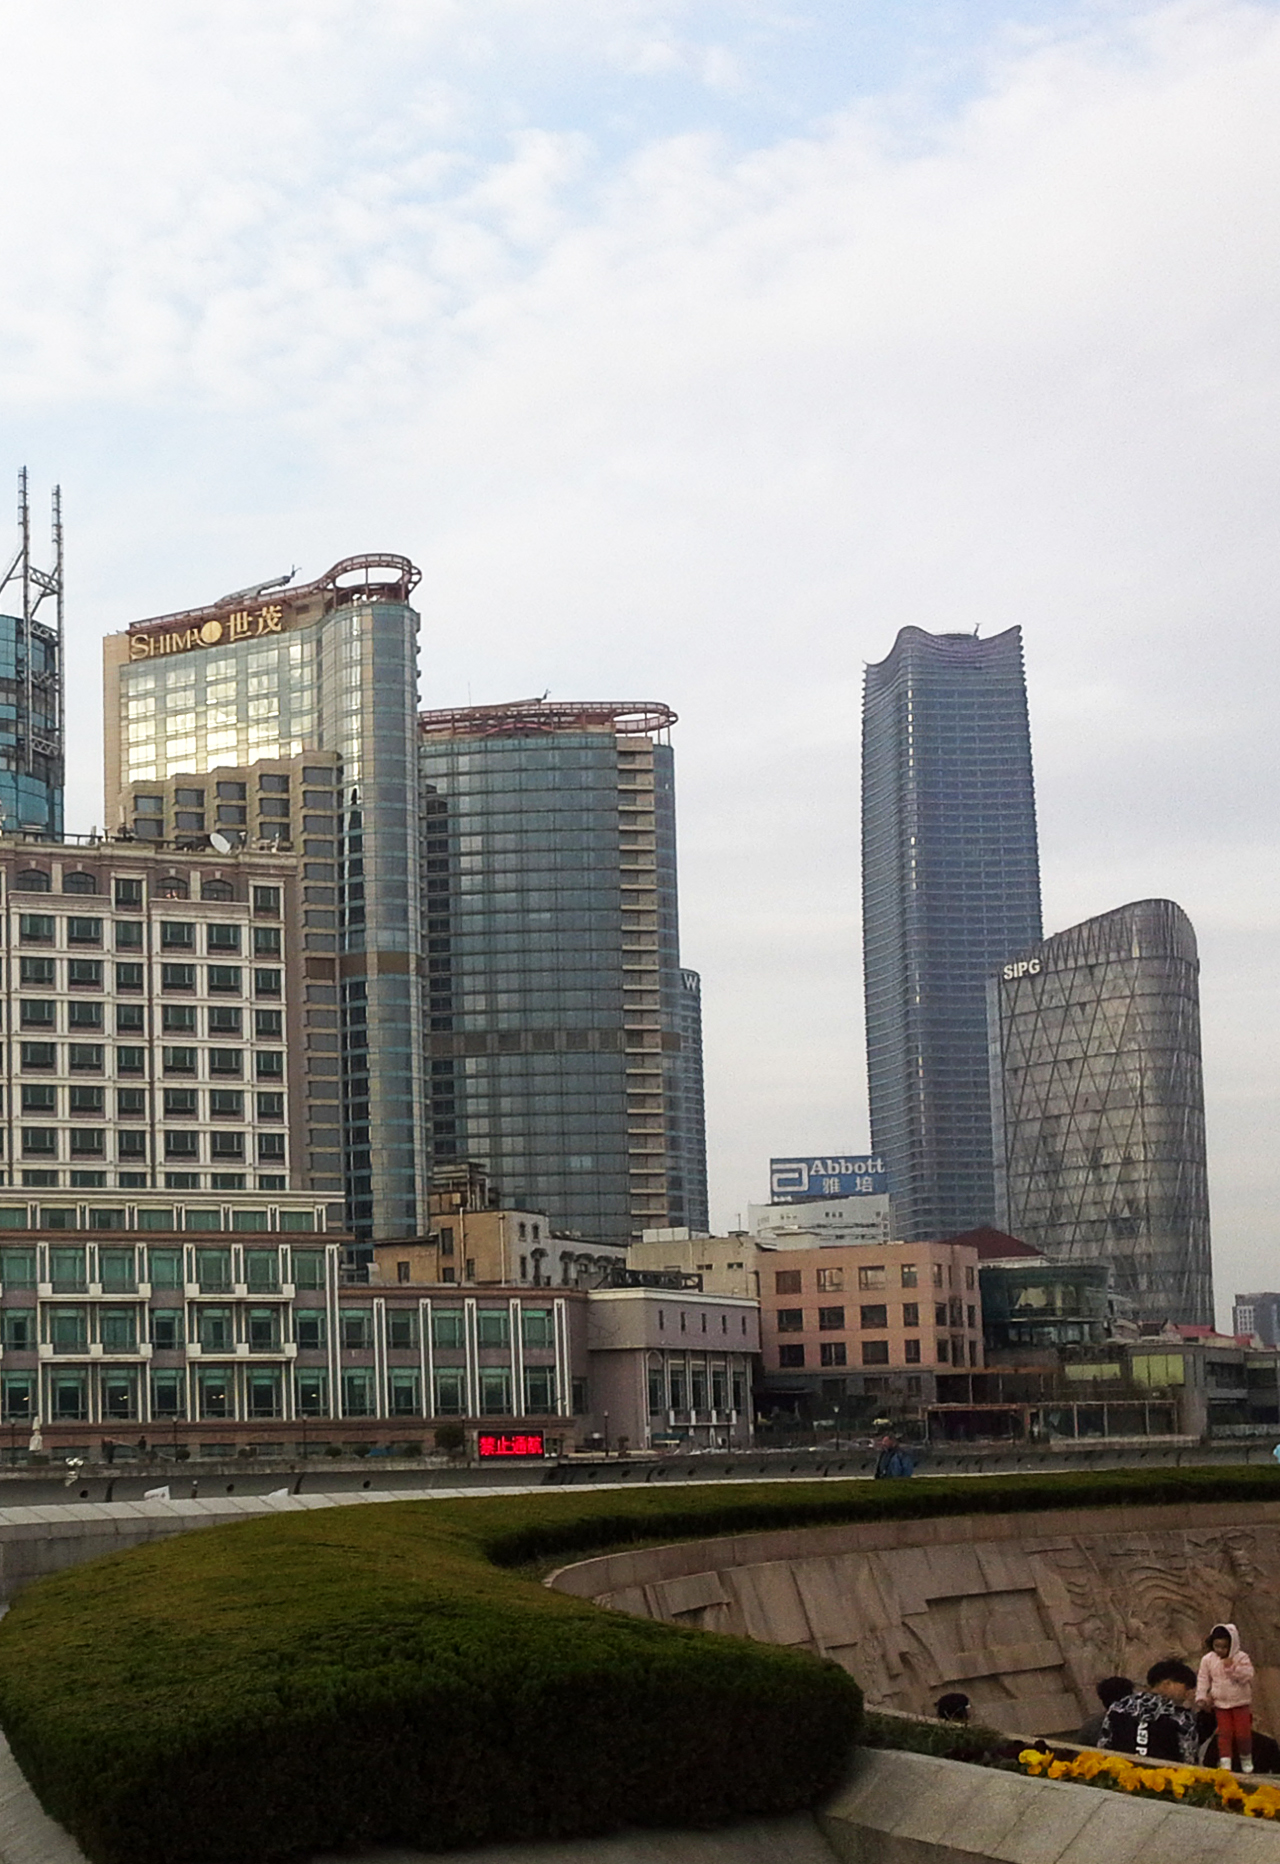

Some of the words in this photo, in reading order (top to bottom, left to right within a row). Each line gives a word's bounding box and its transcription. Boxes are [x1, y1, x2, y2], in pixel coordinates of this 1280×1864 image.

[226, 605, 283, 642] 世茂
[1003, 959, 1041, 980] SIPG
[809, 1158, 886, 1176] Abbott
[823, 1175, 874, 1194] 雅培
[480, 1435, 543, 1456] 禁止通航
